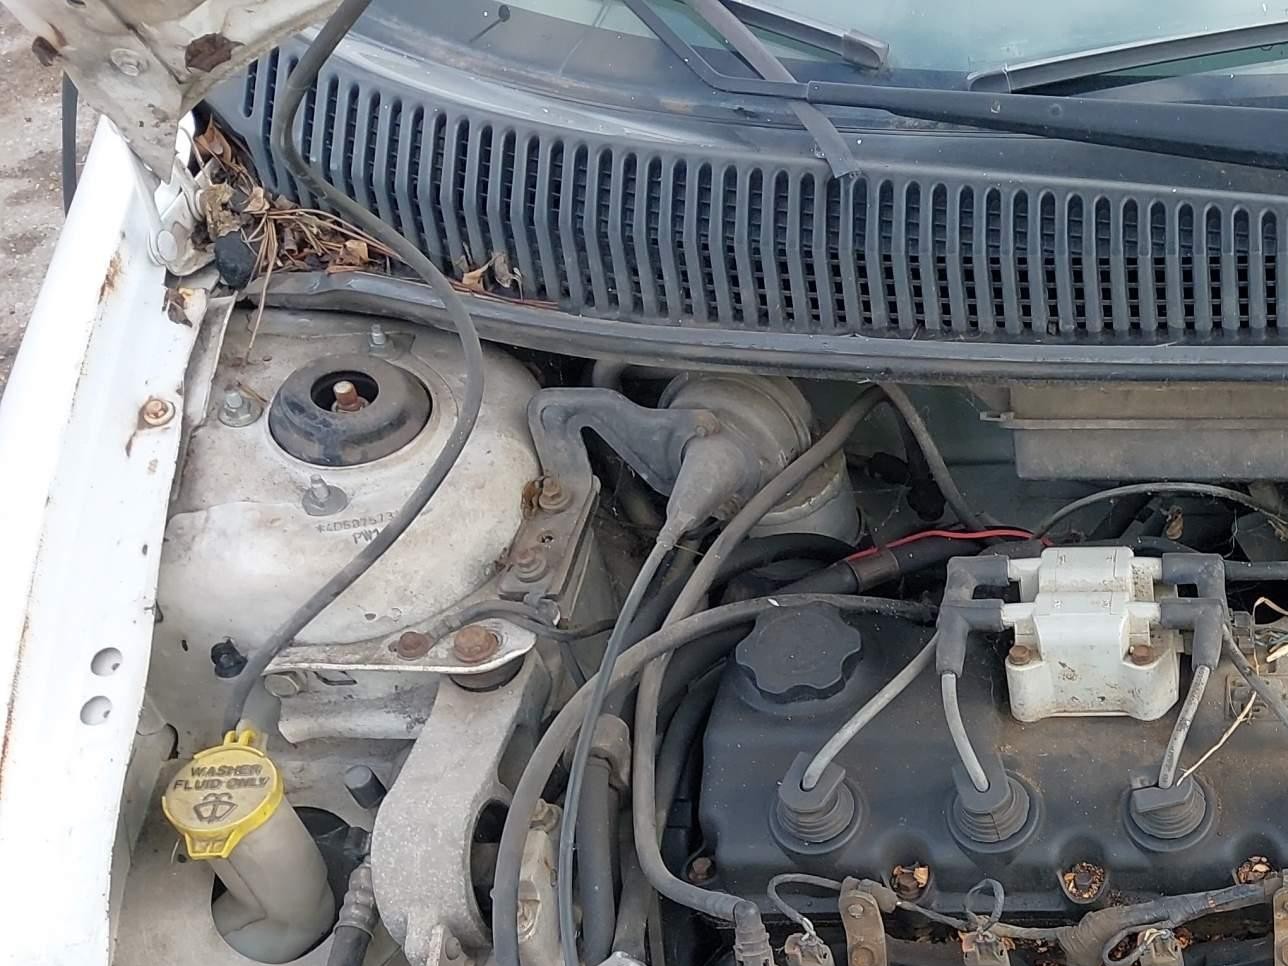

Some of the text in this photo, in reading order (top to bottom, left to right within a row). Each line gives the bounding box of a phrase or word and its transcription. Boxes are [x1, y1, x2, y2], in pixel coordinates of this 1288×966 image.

[191, 764, 263, 777] WASHER
[173, 776, 270, 790] FLUID ONLY
